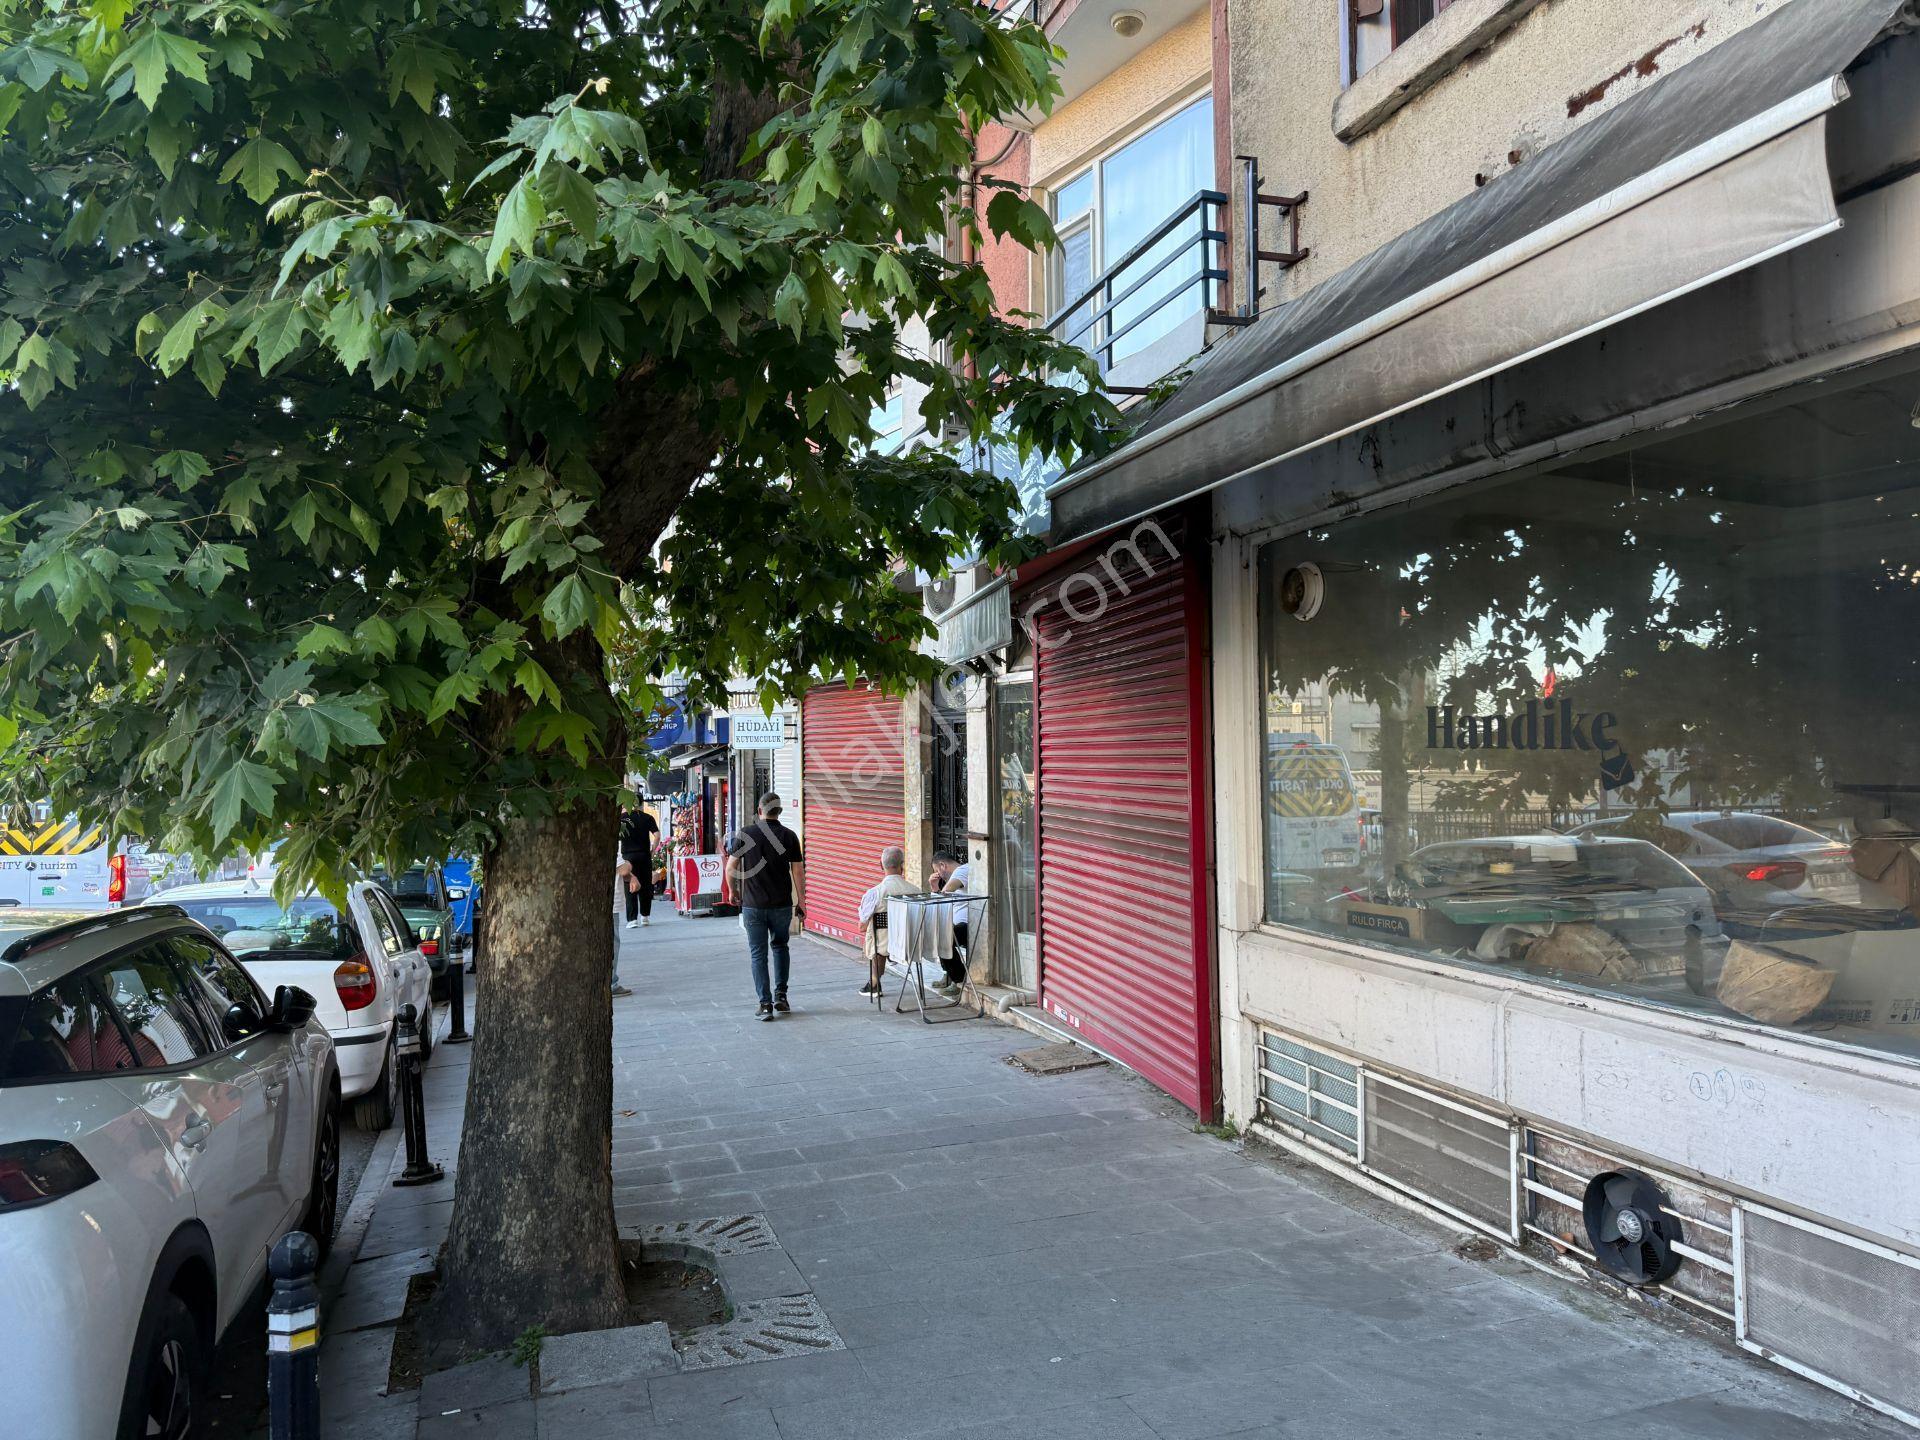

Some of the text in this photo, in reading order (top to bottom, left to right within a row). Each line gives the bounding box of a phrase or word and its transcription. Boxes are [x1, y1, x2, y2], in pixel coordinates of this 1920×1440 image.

[737, 718, 780, 732] HÜDAYİ
[1426, 697, 1619, 751] Handike
[735, 735, 781, 743] KUYUMCULUK
[40, 861, 78, 870] turizm
[1352, 915, 1404, 931] RULO FIRÇA
